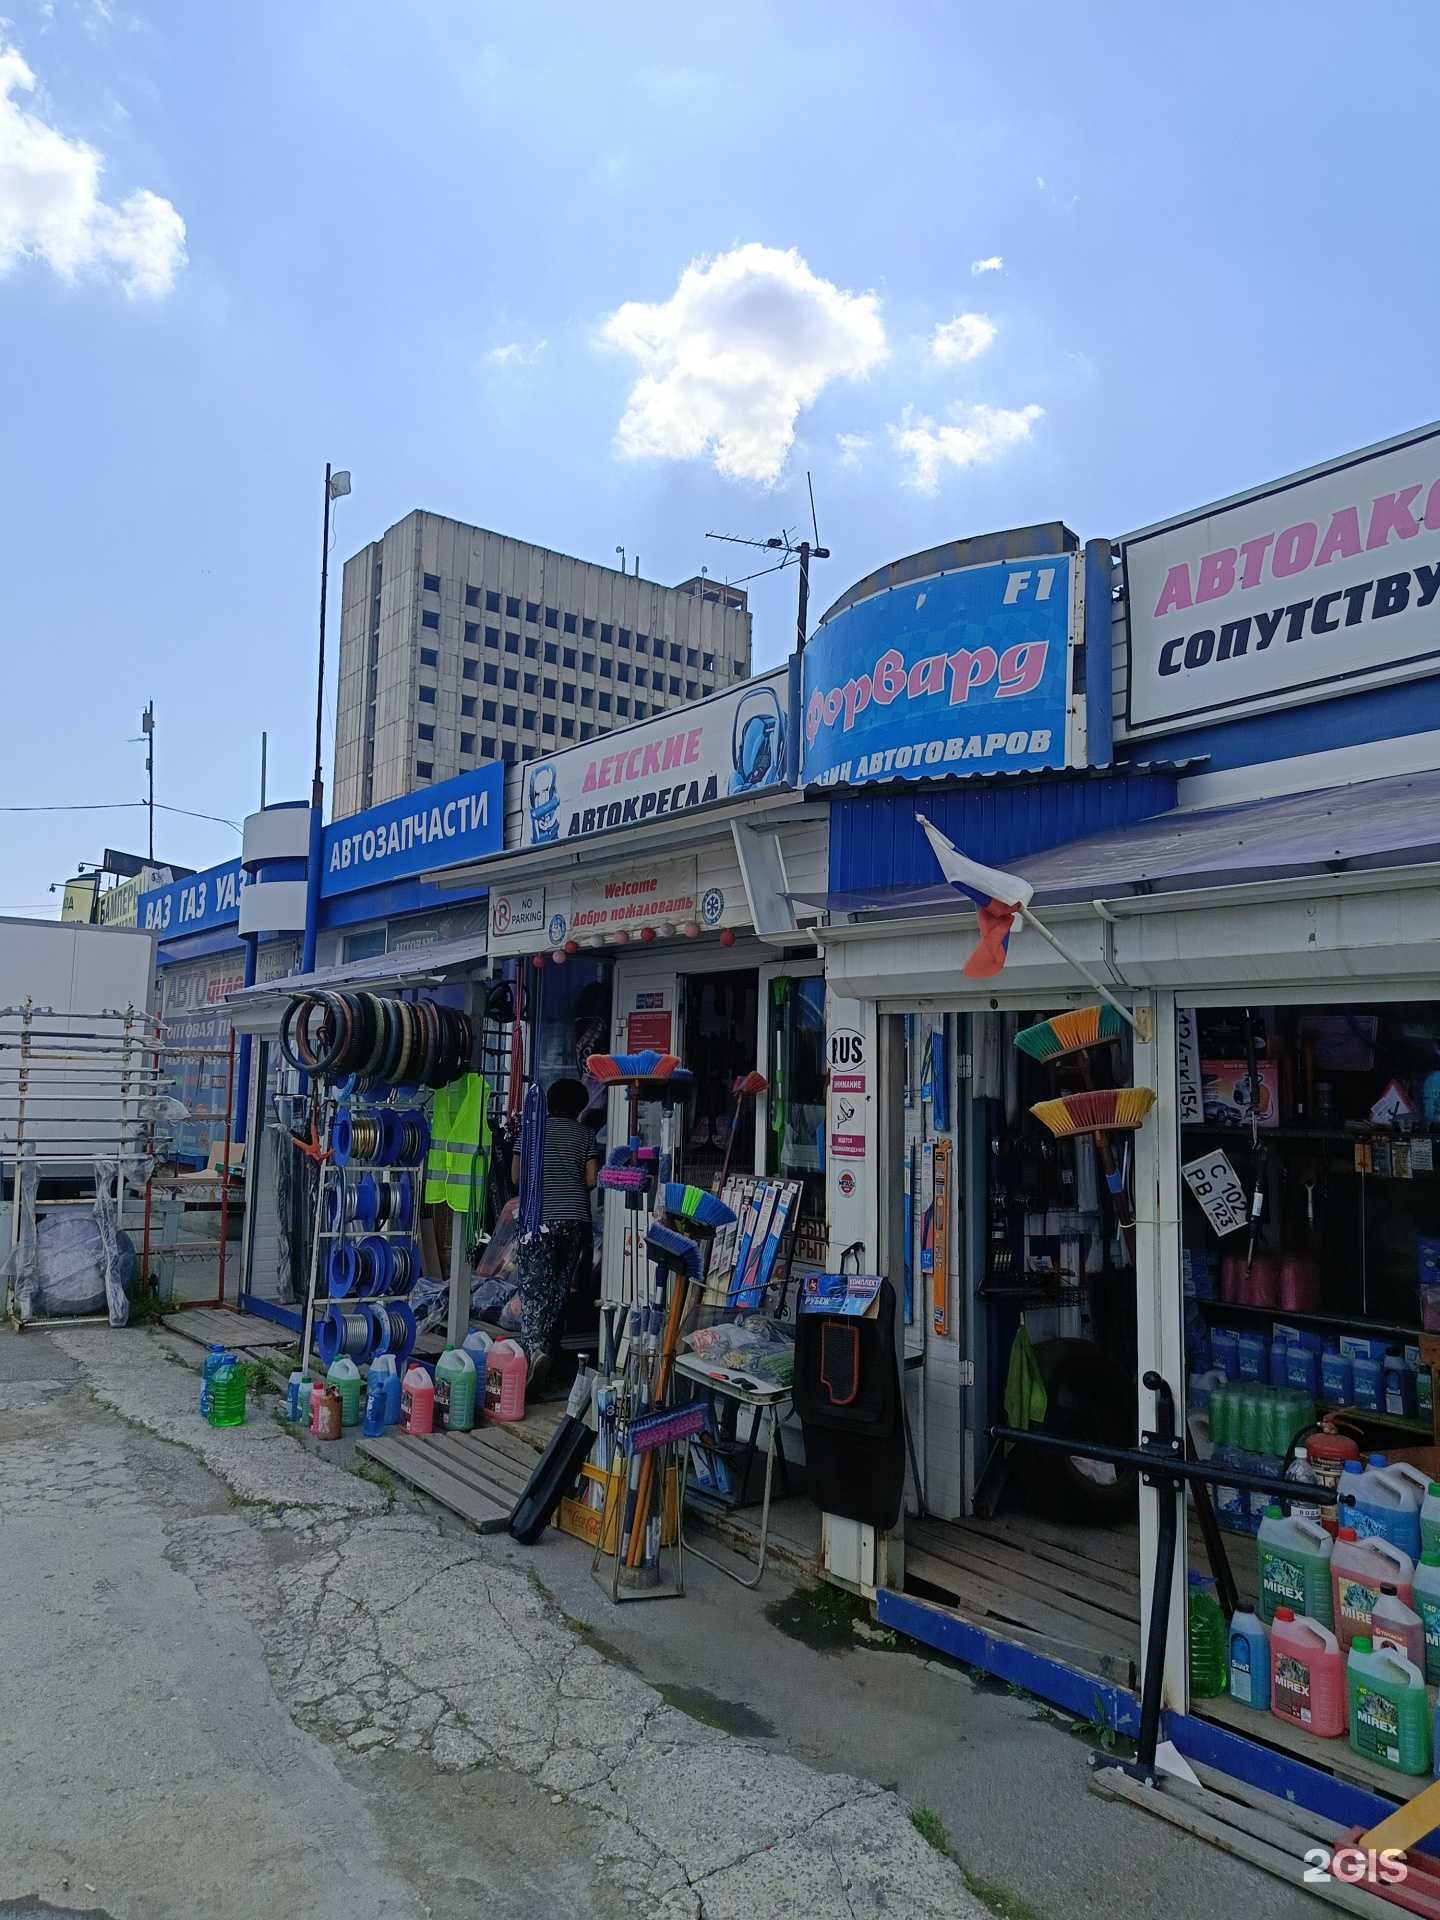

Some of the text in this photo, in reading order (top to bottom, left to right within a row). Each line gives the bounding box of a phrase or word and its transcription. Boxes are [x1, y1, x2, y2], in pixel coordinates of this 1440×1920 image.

[1003, 568, 1056, 605] F1
[581, 728, 703, 794] ДЕТСКИЕ
[855, 730, 1052, 778] АВТОТОВАРОВ
[567, 775, 719, 837] АВТОКРЕСЛА
[329, 791, 489, 873] АВТОЗАПЧАСТИ
[604, 879, 657, 899] Welcome
[144, 894, 172, 929] ВАЗ
[178, 882, 207, 924] ГАЗ
[521, 899, 533, 909] NO
[572, 896, 694, 928] Добро пожаловать
[511, 911, 542, 925] PARKING
[832, 1036, 862, 1064] RUS
[1213, 1203, 1233, 1226] 123
[1263, 1578, 1305, 1602] MIREX
[1341, 1606, 1373, 1625] MIRE
[1275, 1674, 1310, 1697] MIREX
[1357, 1710, 1398, 1736] MIREX
